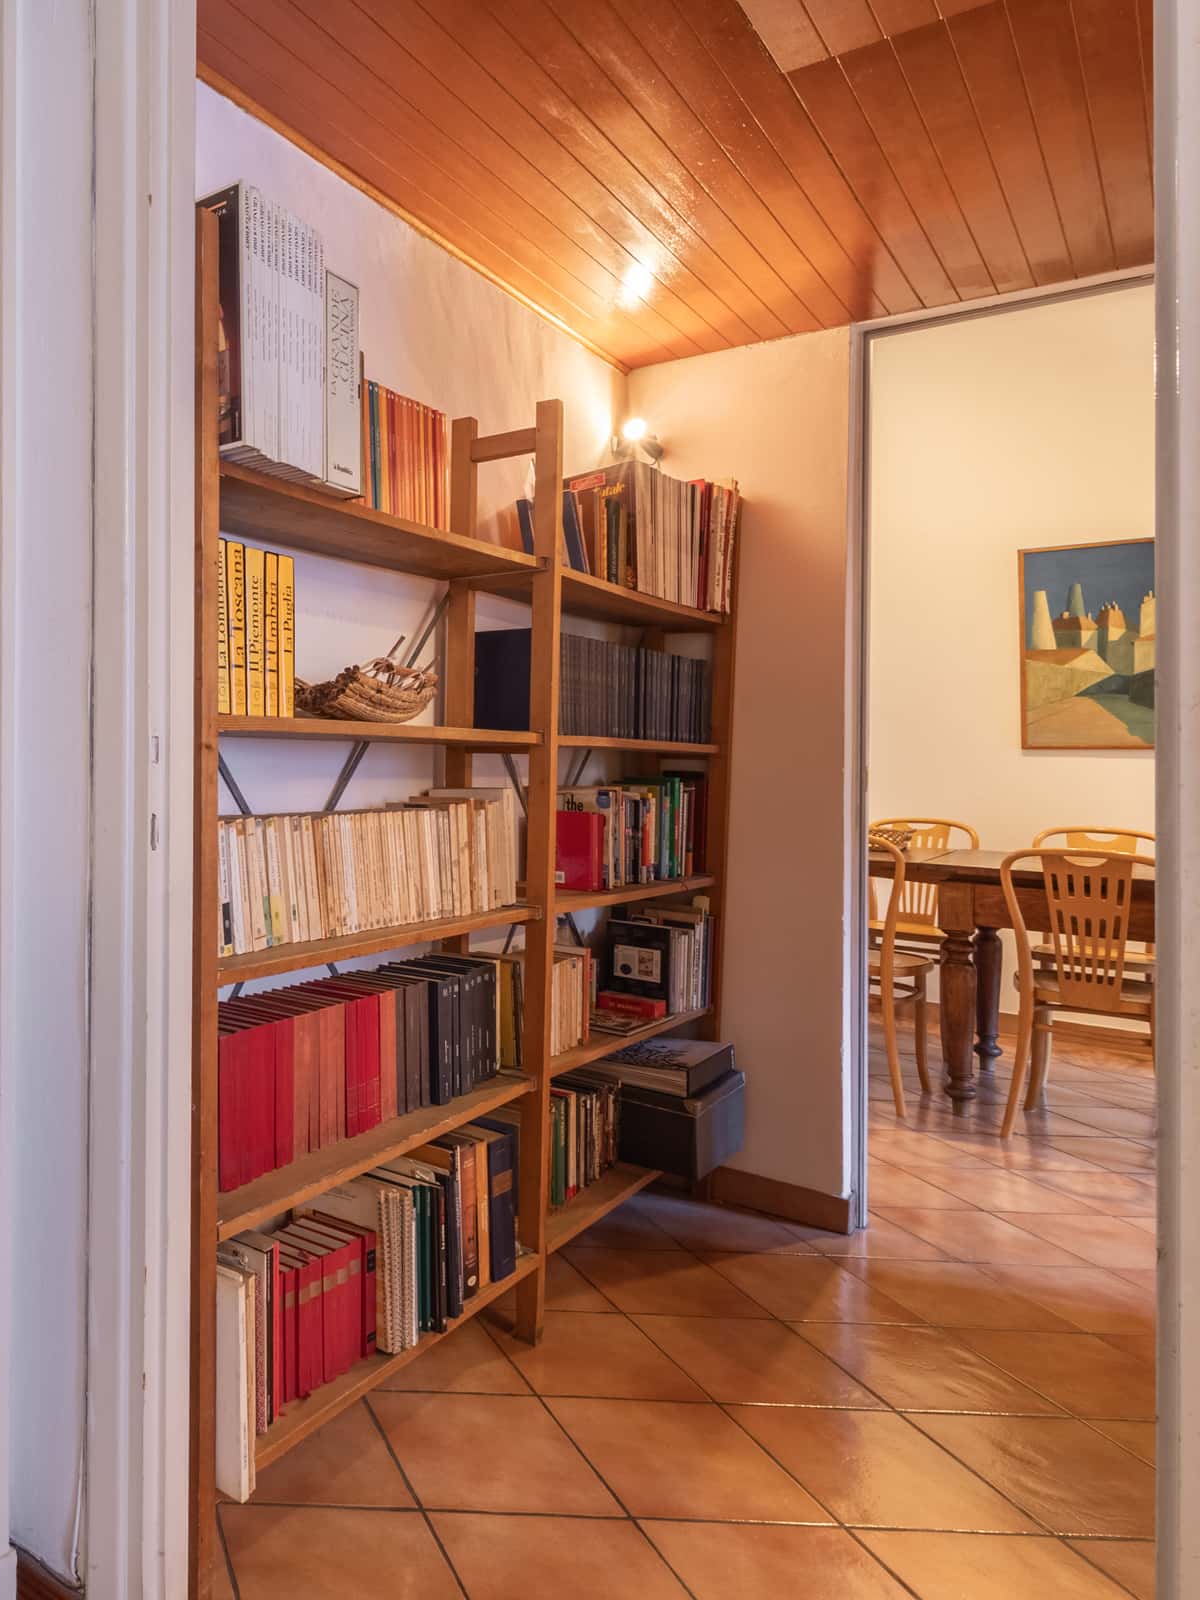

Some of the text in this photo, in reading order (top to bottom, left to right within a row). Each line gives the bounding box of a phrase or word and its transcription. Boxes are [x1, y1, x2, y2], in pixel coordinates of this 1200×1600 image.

[230, 549, 244, 670] La Toscana
[248, 576, 259, 672] Il Piemonte
[282, 585, 293, 654] La Puglia
[566, 793, 584, 812] the
